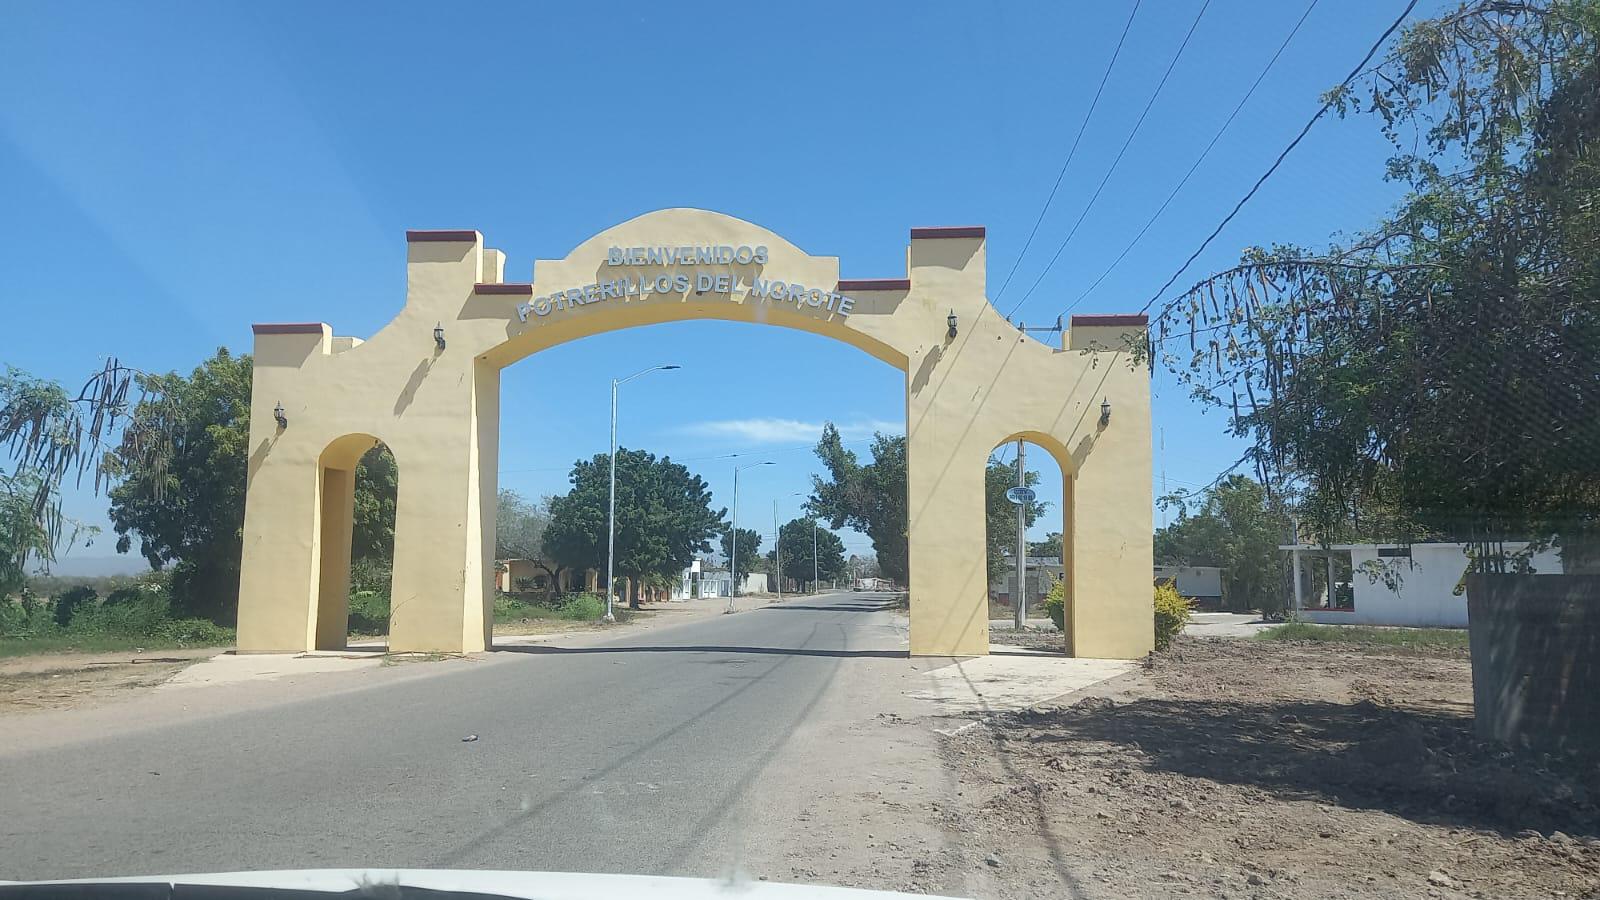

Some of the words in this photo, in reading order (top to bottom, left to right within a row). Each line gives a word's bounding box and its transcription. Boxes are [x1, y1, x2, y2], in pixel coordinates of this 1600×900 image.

[607, 245, 769, 267] BIENVENIDOS
[515, 274, 690, 323] POTRERILLOS
[697, 272, 749, 294] DEL
[752, 277, 856, 317] NOROTE
